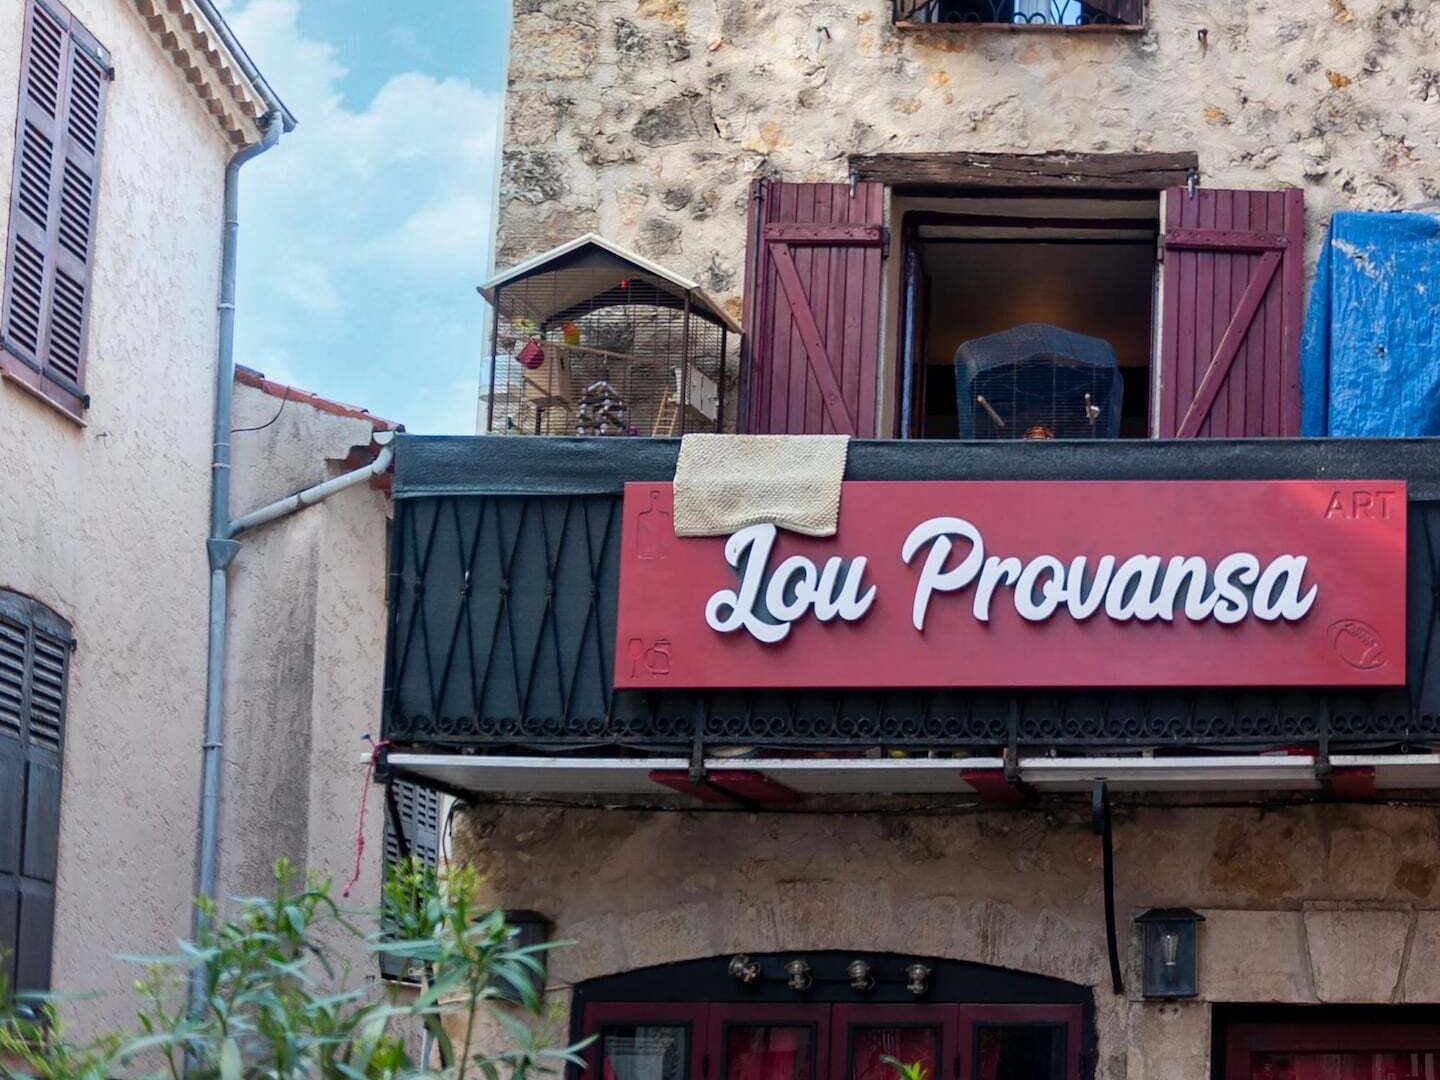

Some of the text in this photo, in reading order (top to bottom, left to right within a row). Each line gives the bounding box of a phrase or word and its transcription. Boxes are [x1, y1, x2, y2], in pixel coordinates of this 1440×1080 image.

[1323, 489, 1397, 520] ART
[704, 516, 1319, 644] Lou Provansa
